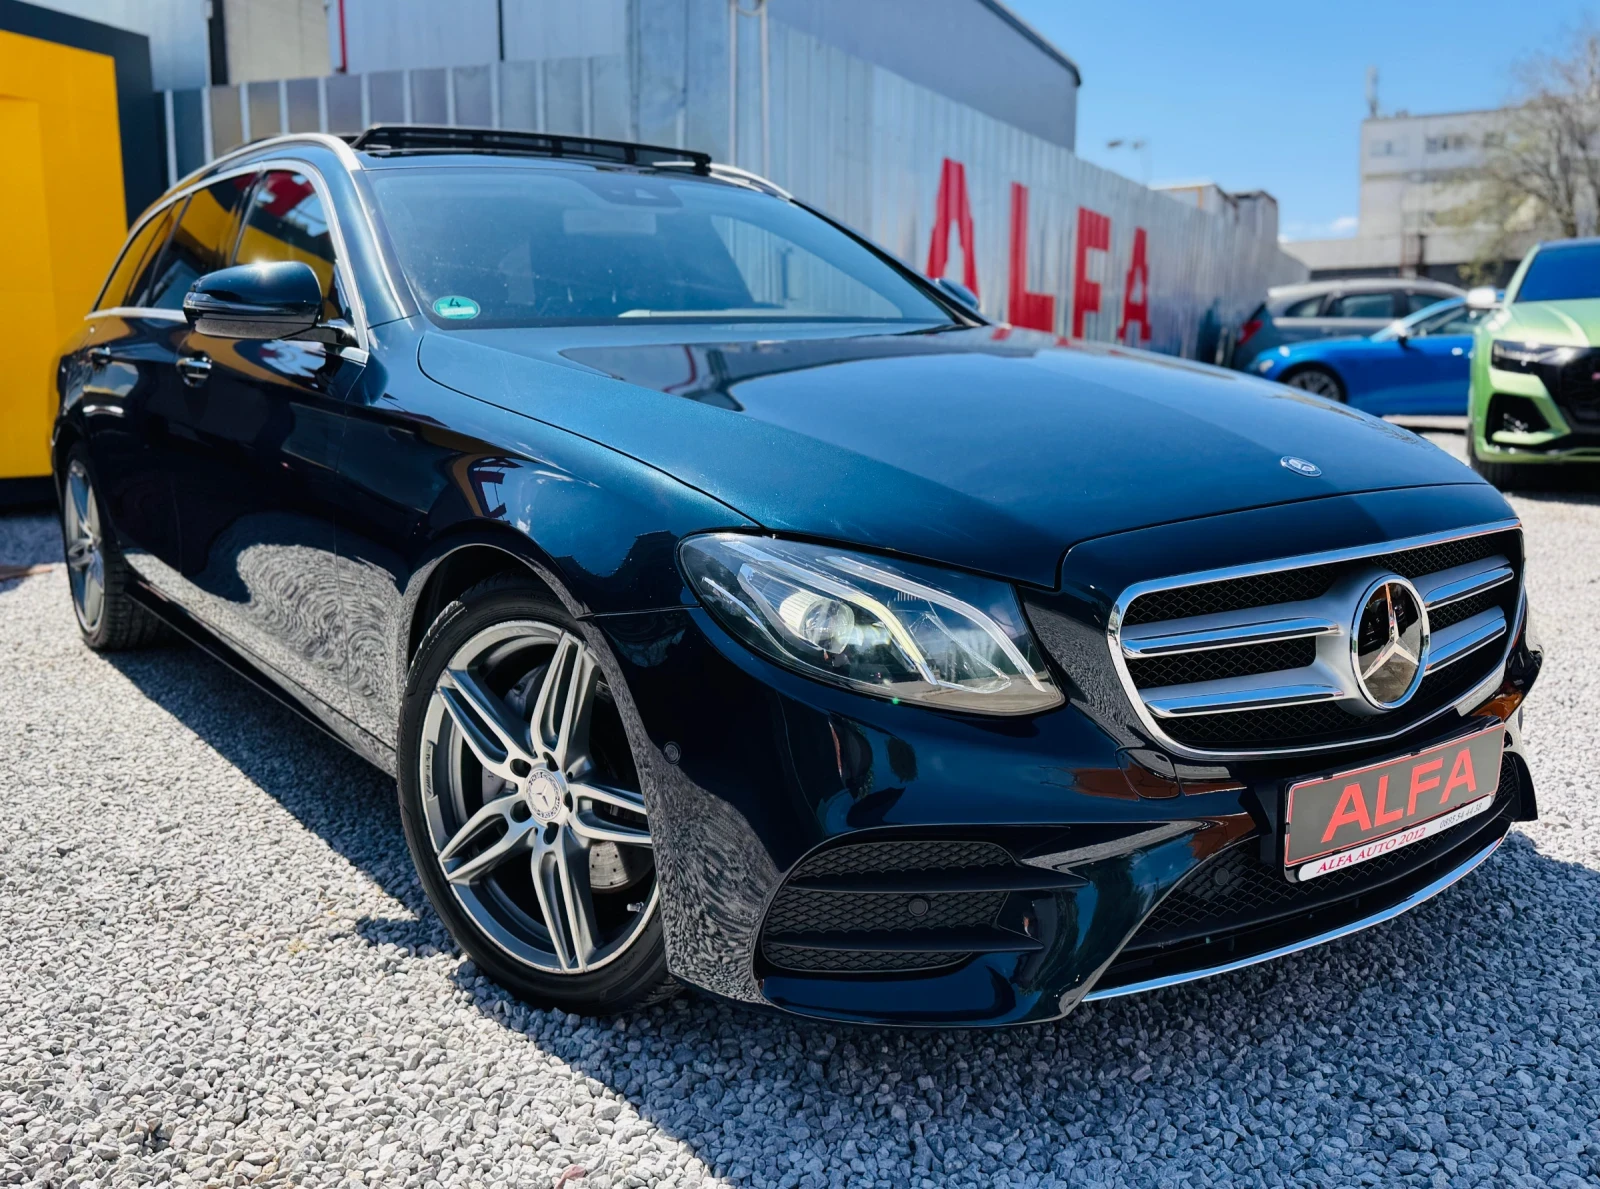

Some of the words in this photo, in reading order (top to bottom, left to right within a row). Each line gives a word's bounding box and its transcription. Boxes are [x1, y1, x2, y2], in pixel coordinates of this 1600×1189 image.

[925, 156, 1152, 342] ALFA
[1321, 748, 1477, 843] ALFA
[1316, 853, 1353, 874] ALFA
[1356, 838, 1397, 861] AUTO
[1398, 827, 1426, 845] 2012
